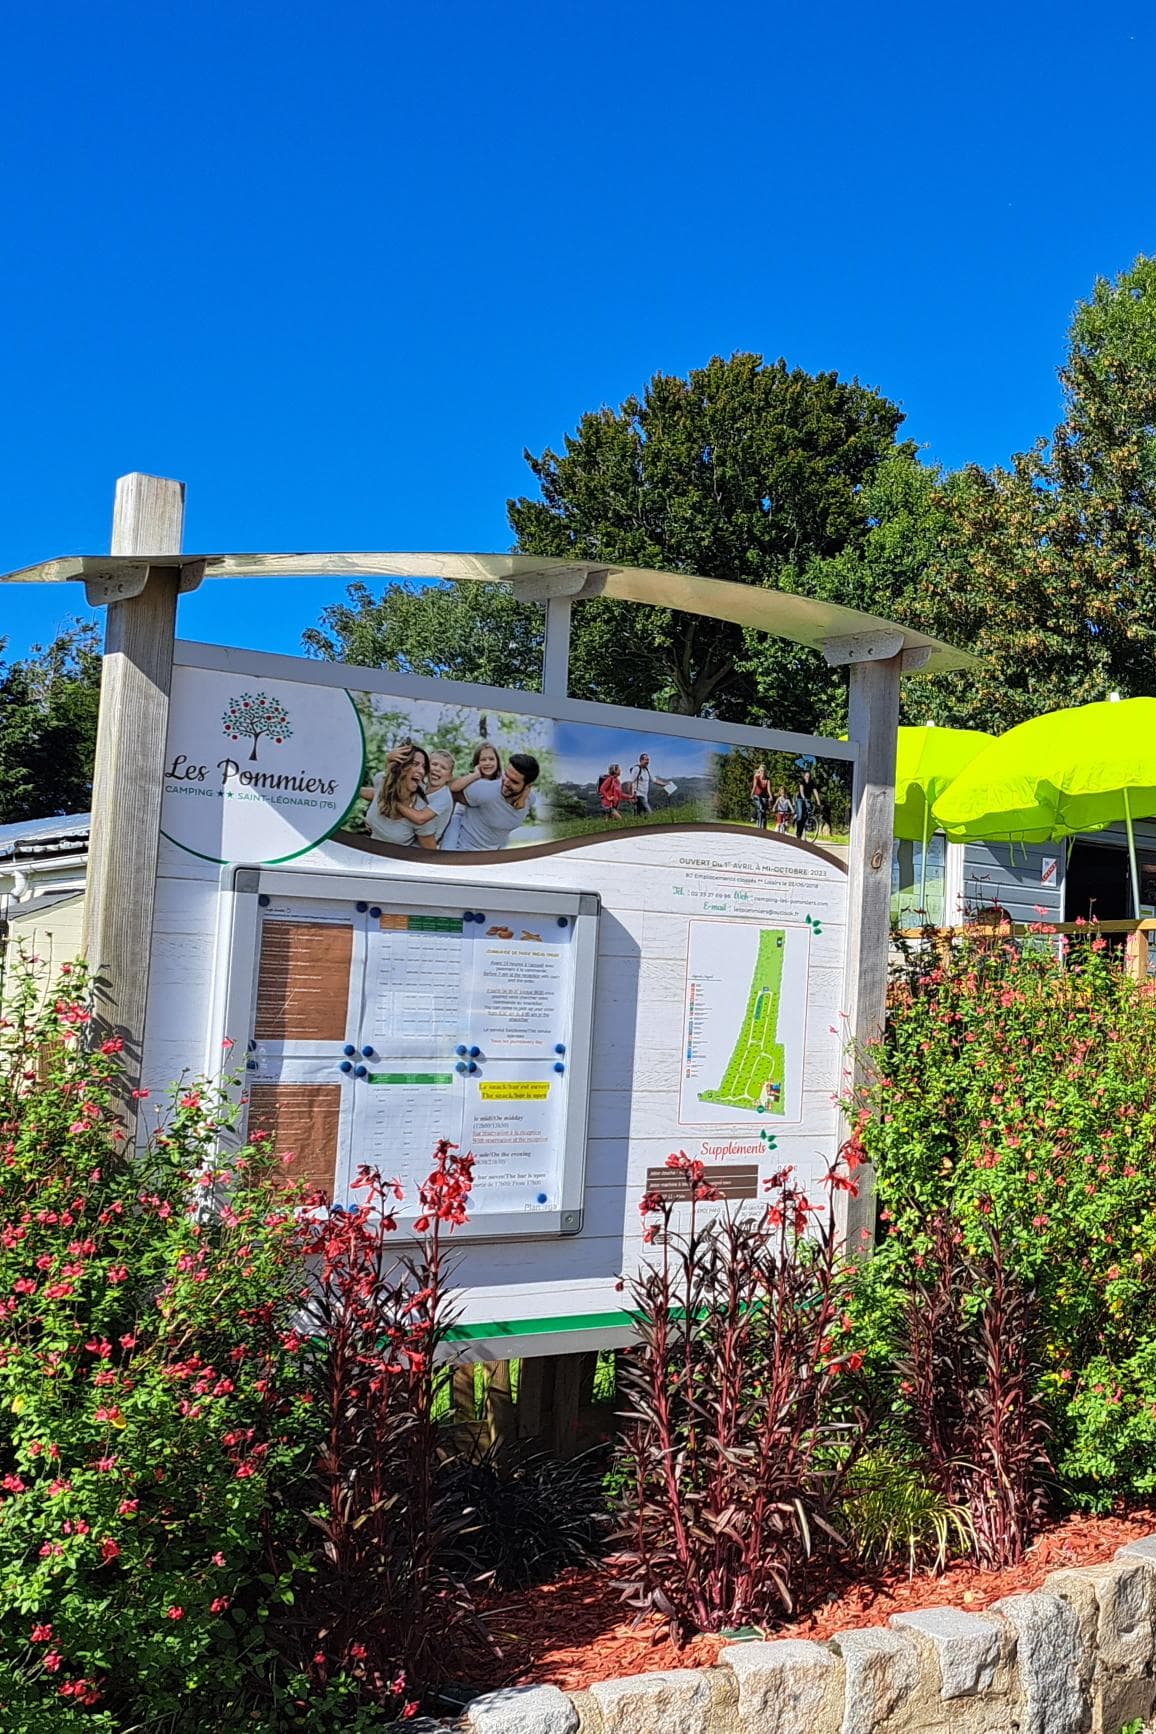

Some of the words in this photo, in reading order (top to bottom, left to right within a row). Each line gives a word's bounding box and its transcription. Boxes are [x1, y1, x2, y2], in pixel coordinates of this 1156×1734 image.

[164, 754, 210, 782] Les
[216, 757, 339, 796] Pommiers
[165, 785, 213, 798] CAMPING
[237, 791, 318, 808] SAINT-LÉONARD
[319, 799, 336, 810] (76)
[679, 857, 711, 867] OUVERT
[733, 862, 754, 871] AVRIL
[762, 866, 808, 876] MI-OCTOBRE
[809, 869, 827, 877] 2023
[703, 901, 727, 912] E-mail
[700, 1141, 767, 1161] Suppléments
